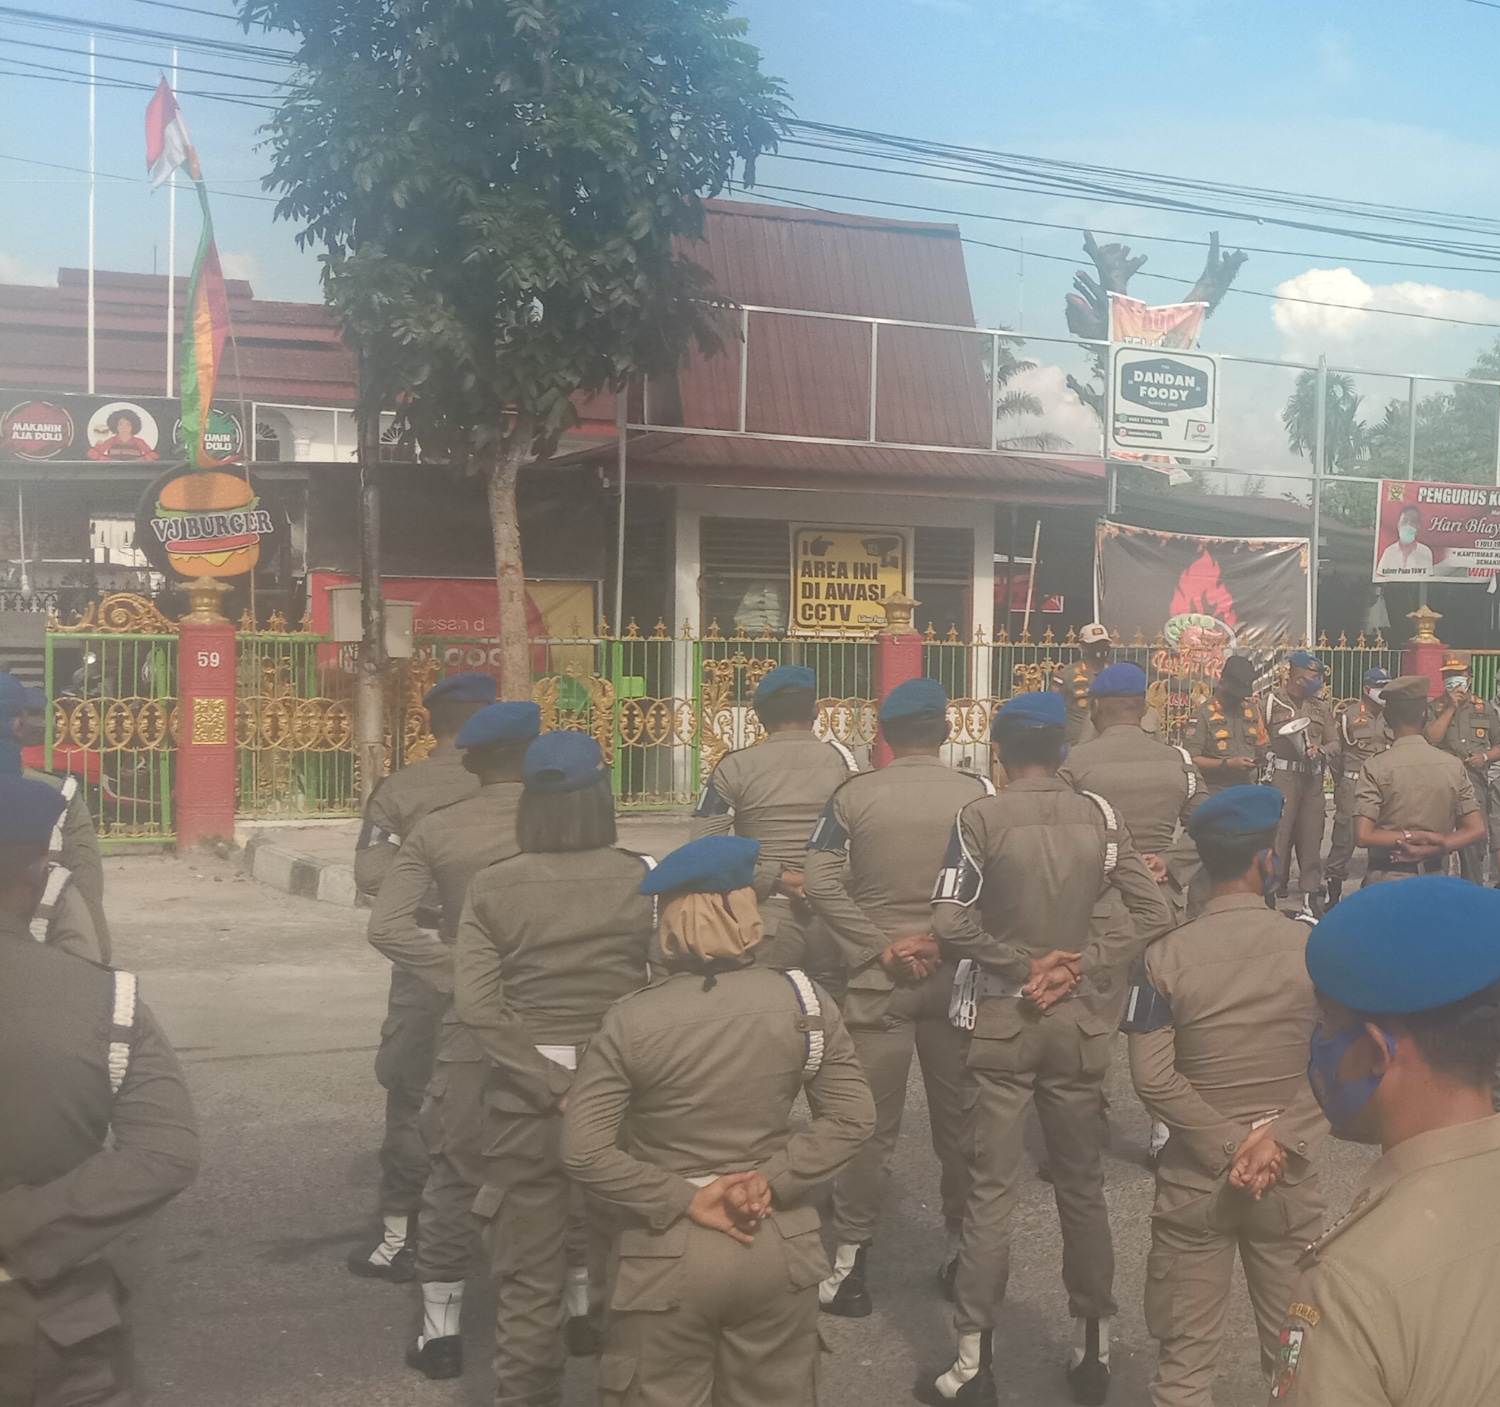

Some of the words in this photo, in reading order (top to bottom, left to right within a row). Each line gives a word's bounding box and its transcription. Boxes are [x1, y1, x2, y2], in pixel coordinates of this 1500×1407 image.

[1134, 370, 1196, 387] DANDAN
[1140, 386, 1189, 401] FOODY
[12, 423, 62, 432] MAKANIN
[12, 432, 32, 440] AJA
[35, 432, 62, 441] DULU
[1418, 486, 1486, 506] PENGURUS
[152, 518, 182, 541] VJ
[186, 510, 273, 538] BURGER
[1428, 516, 1462, 532] Hari
[801, 561, 848, 579] AREA
[853, 563, 878, 580] INI
[802, 582, 820, 600] DI
[825, 583, 886, 601] AWASI
[802, 603, 852, 621] CCTV
[198, 652, 220, 667] 59
